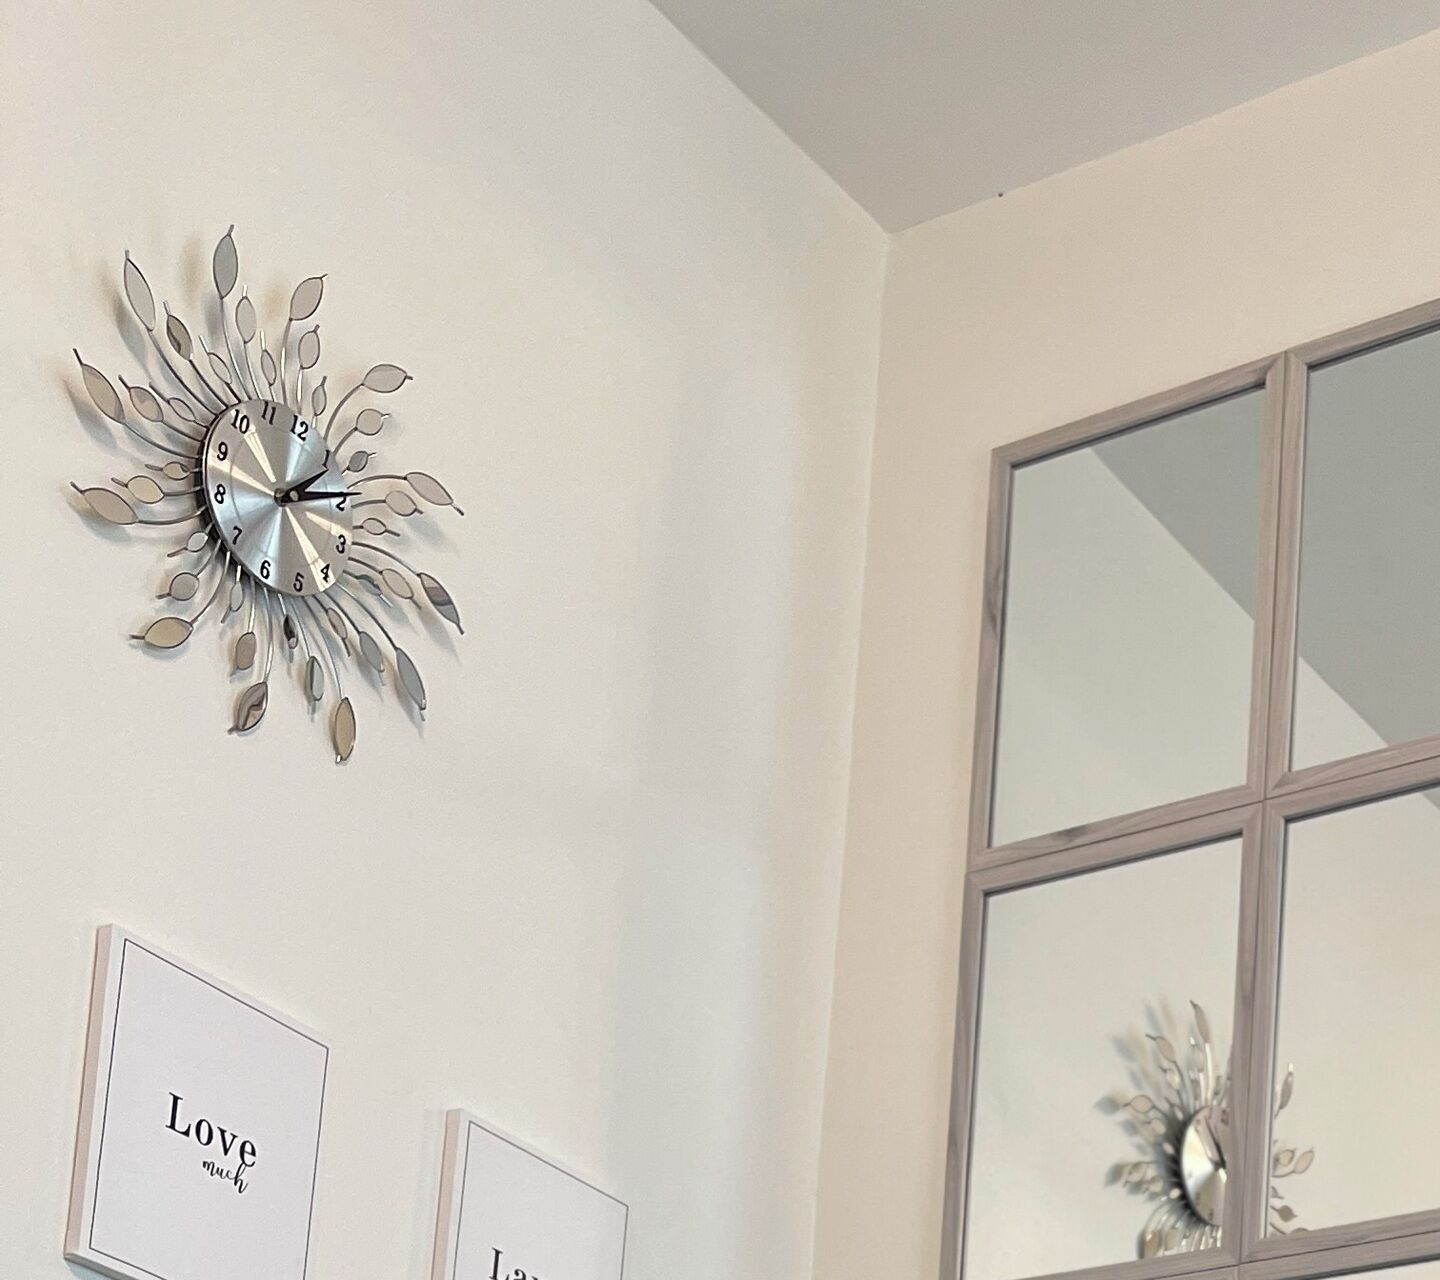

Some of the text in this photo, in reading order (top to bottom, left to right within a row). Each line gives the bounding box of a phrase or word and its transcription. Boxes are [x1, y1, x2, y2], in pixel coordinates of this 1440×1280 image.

[231, 409, 250, 434] 10
[261, 401, 277, 425] 11
[290, 414, 309, 442] 12
[216, 442, 228, 461] 9
[322, 450, 331, 468] 1
[214, 484, 226, 504] 8
[232, 526, 243, 545] 7
[336, 534, 347, 554] 3
[260, 560, 271, 579] 6
[320, 563, 331, 583] 4
[293, 572, 305, 592] 5
[165, 1092, 256, 1167] Love
[202, 1161, 249, 1194] much
